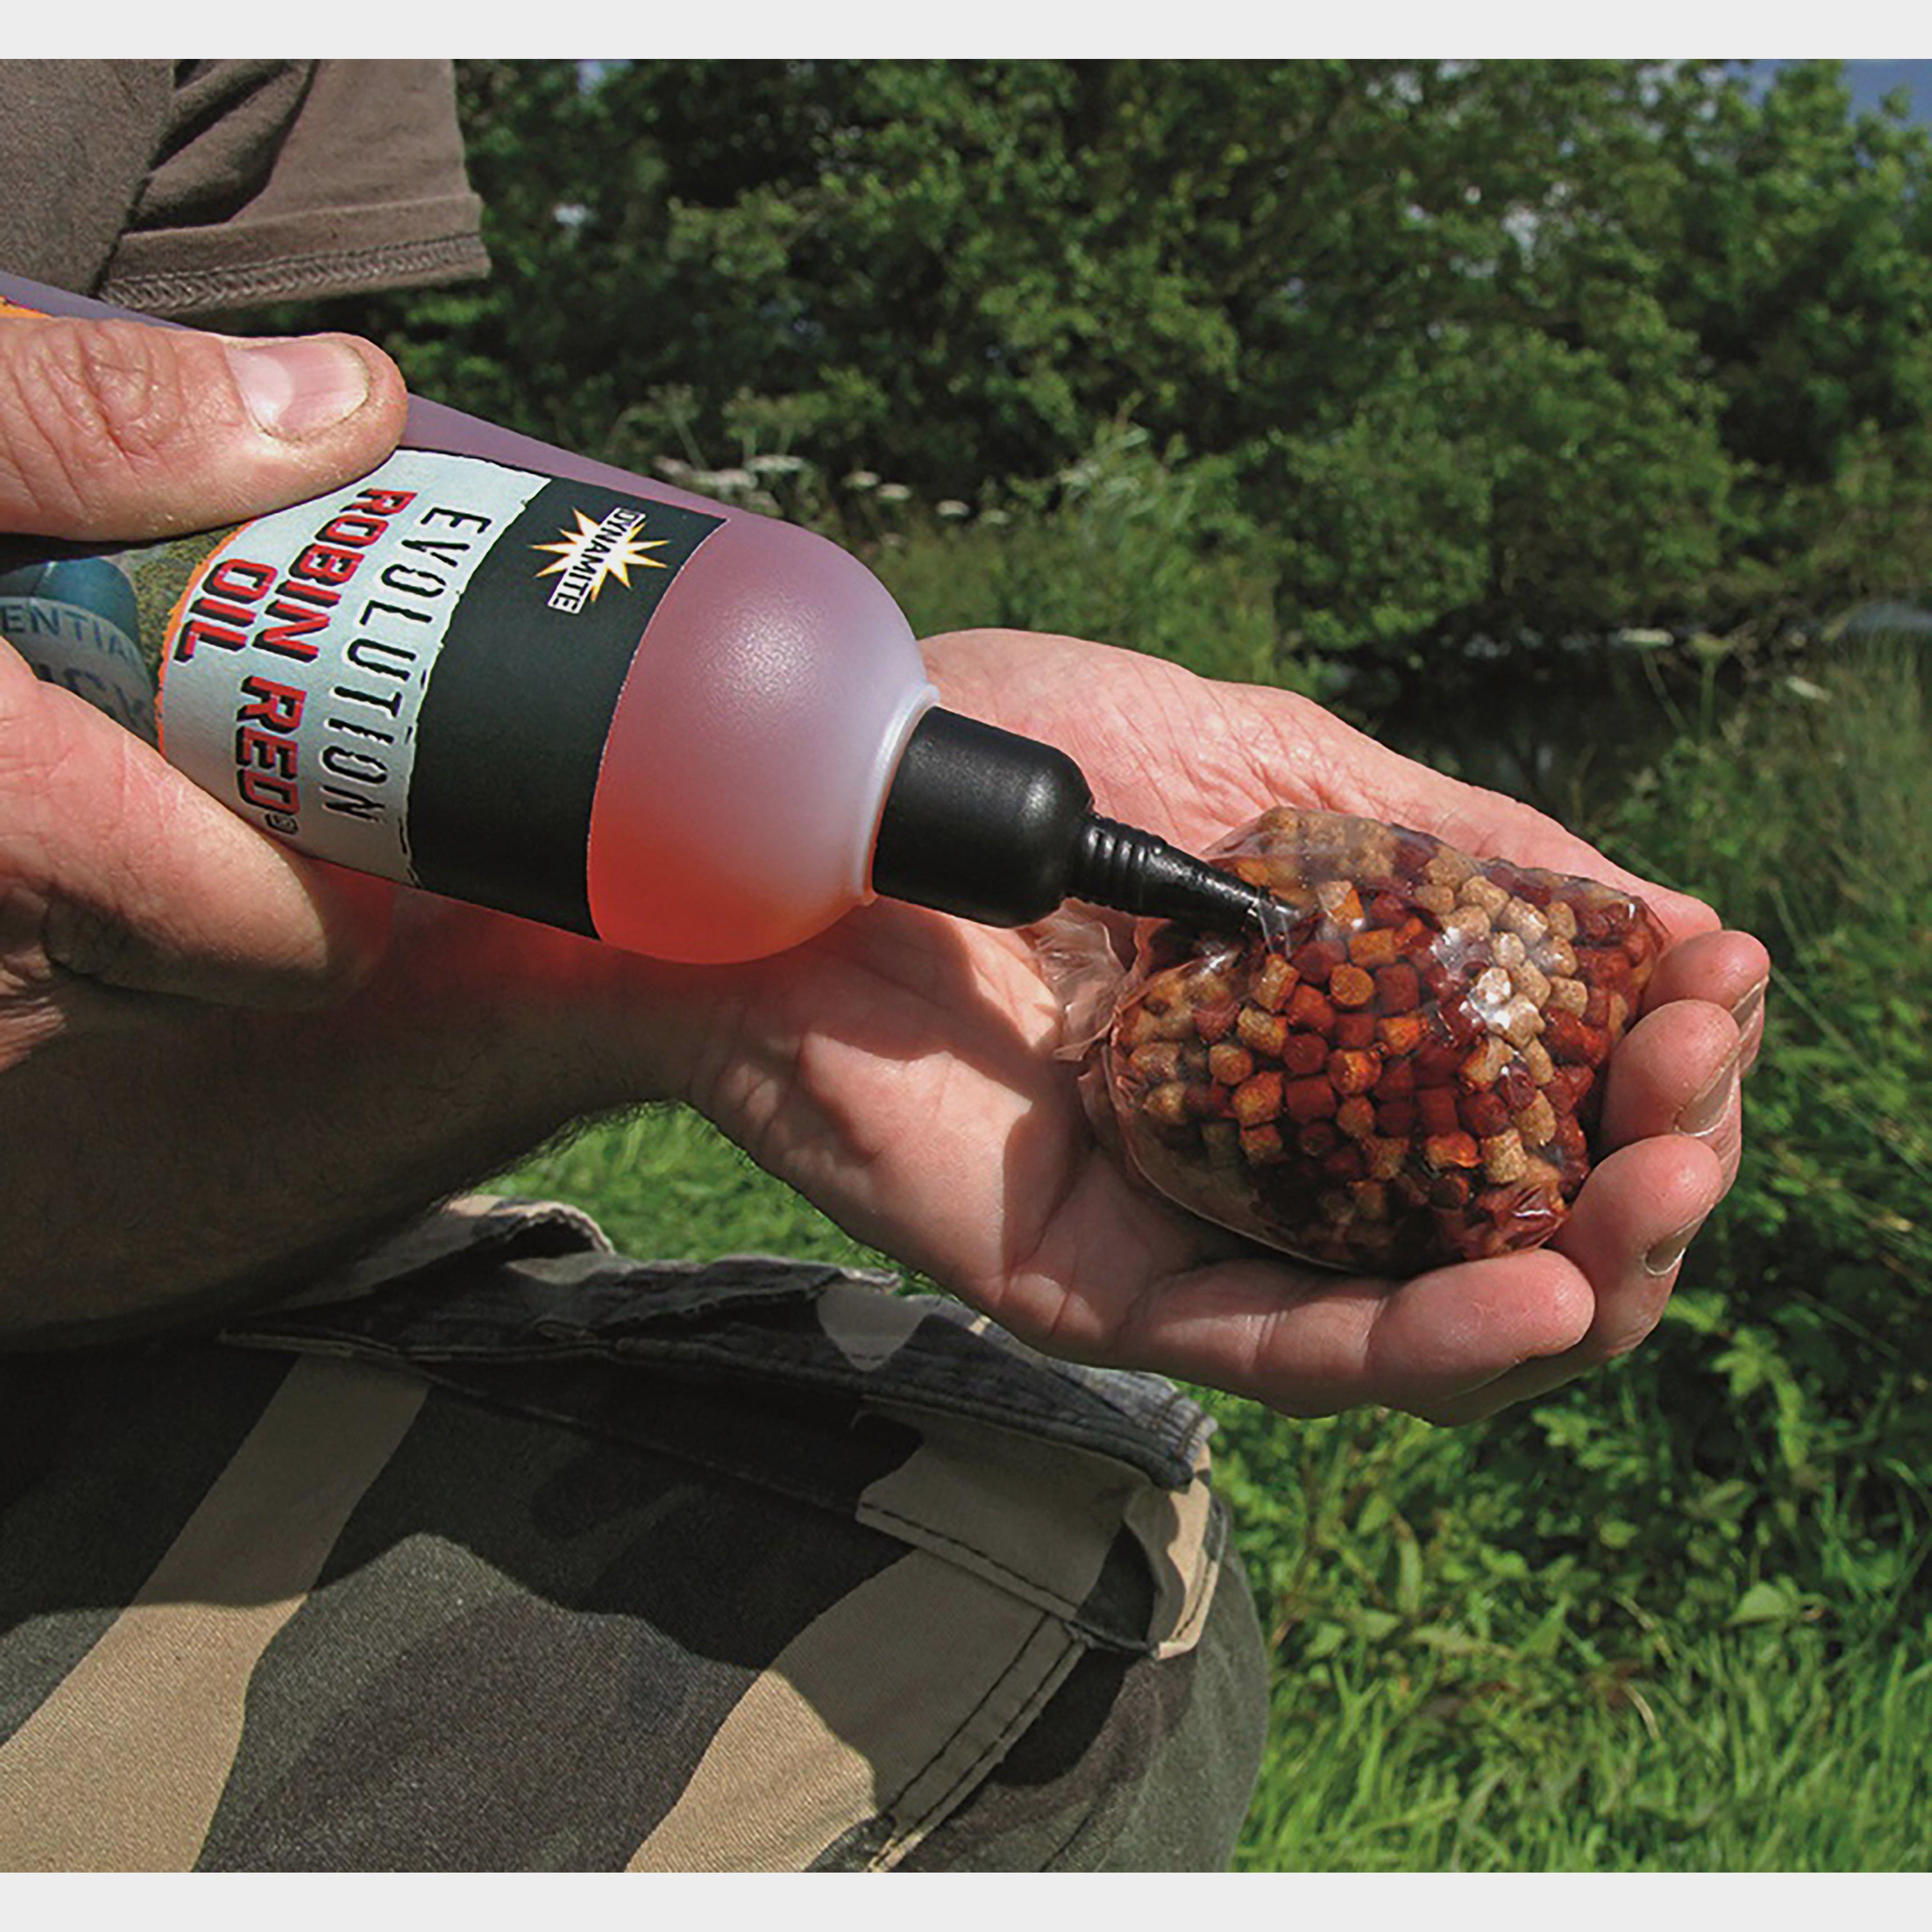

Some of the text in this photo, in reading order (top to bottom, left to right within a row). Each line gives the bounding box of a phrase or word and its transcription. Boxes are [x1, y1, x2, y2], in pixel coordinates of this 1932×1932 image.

[173, 558, 278, 663] OIL
[253, 489, 418, 663] ROBIN
[552, 509, 640, 611] DYNAMITE
[321, 507, 492, 821] EVOLUTION
